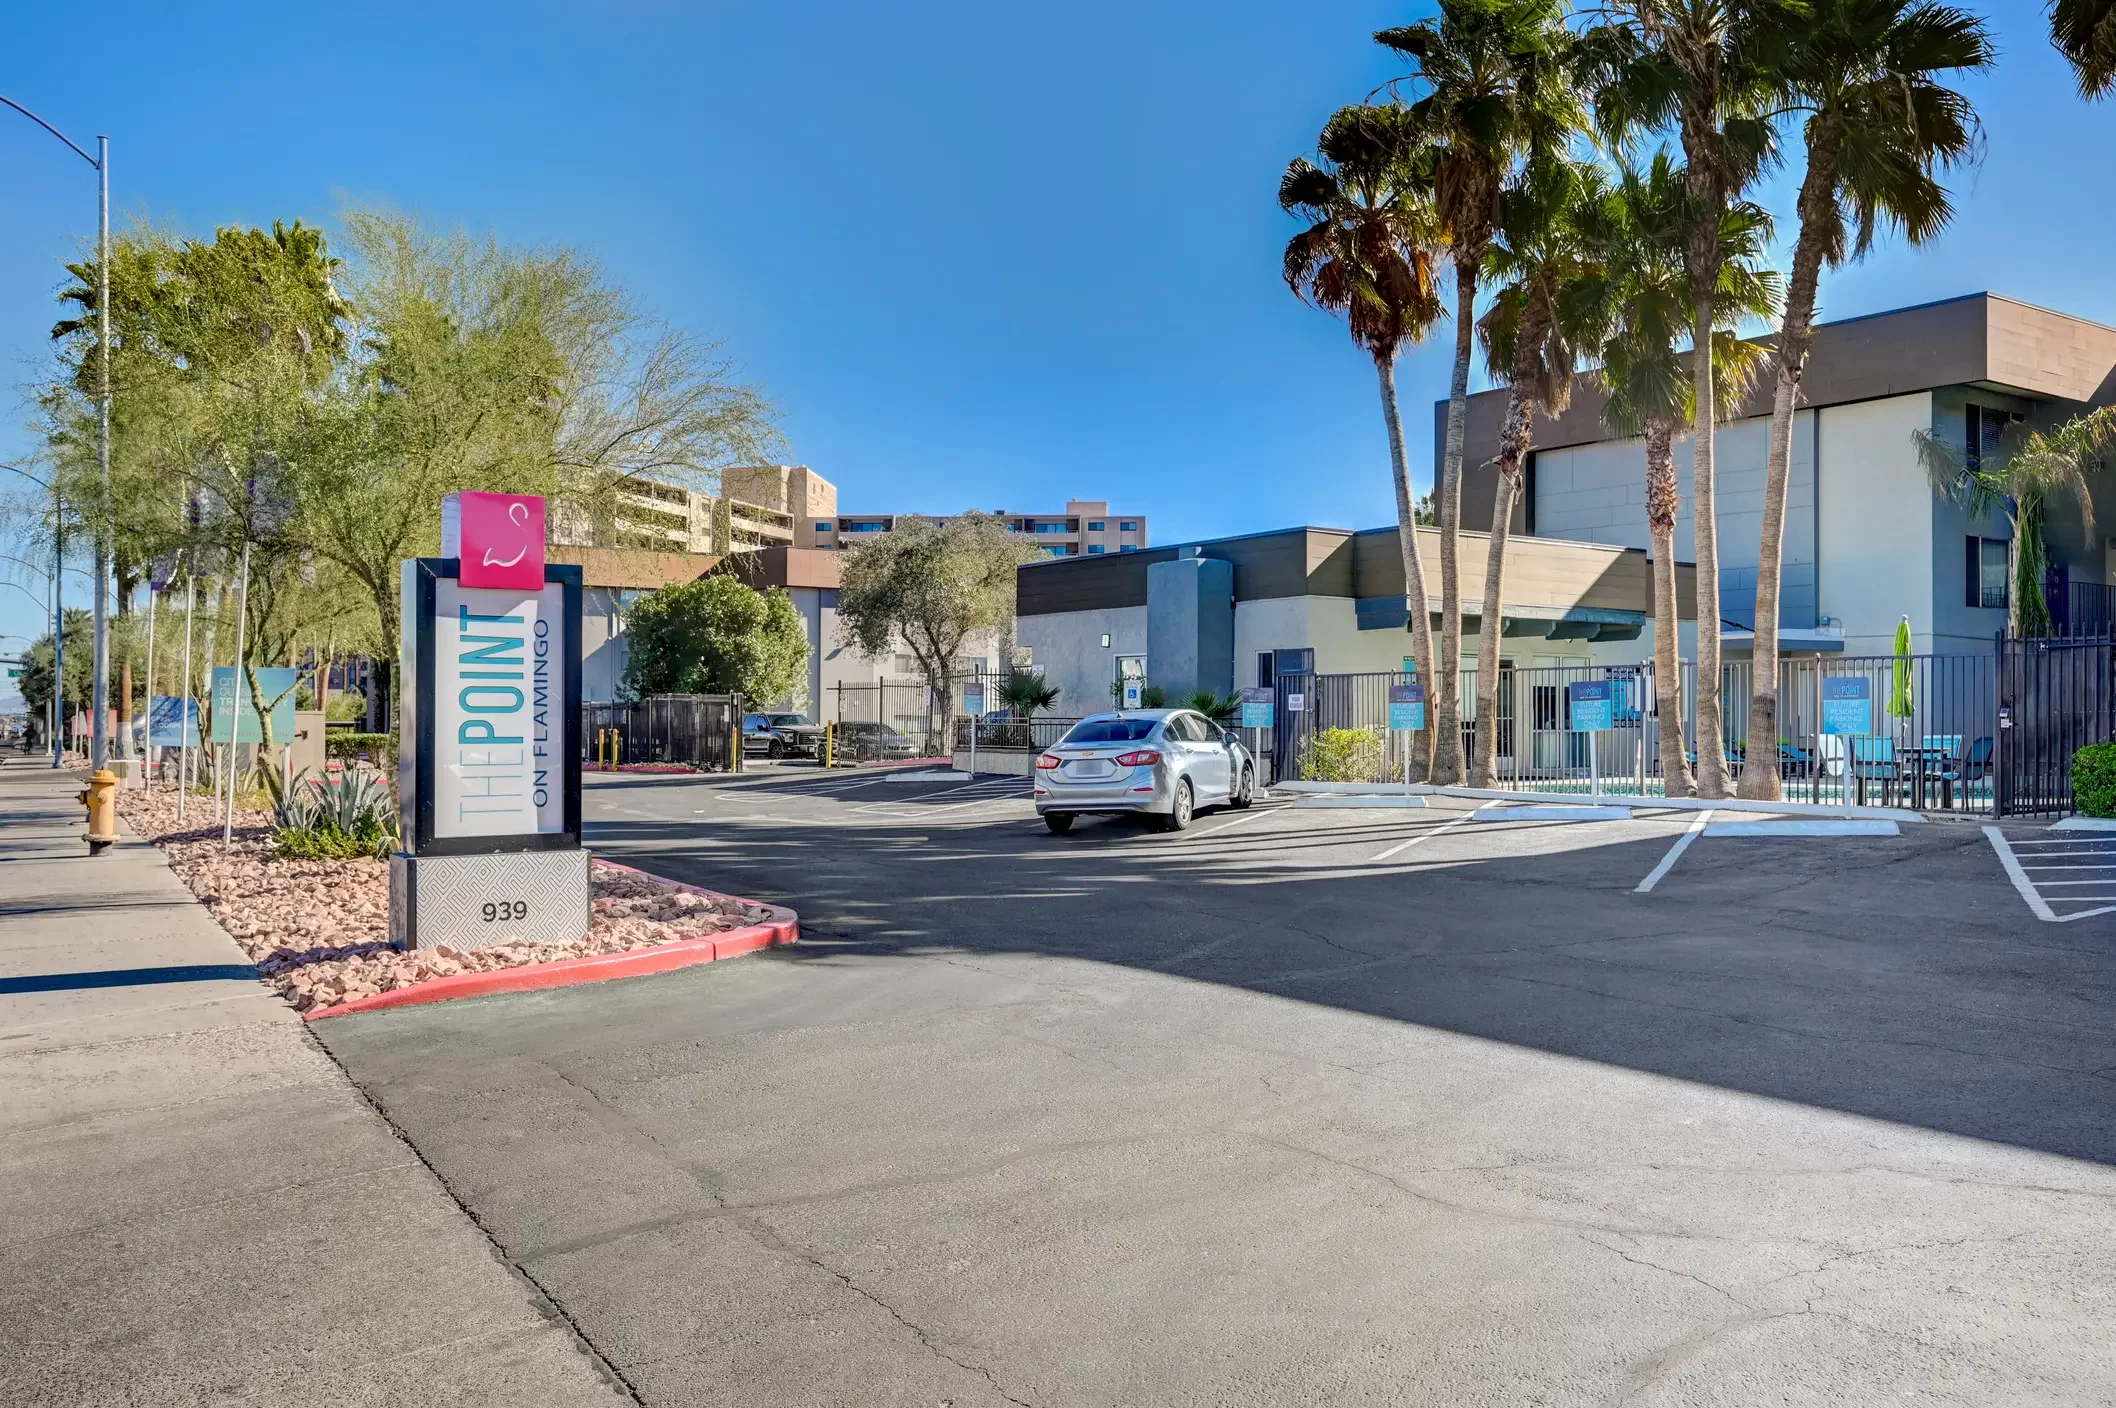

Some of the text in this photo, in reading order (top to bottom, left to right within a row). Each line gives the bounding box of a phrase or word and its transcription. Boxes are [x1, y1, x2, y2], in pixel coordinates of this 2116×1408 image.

[532, 618, 550, 809] ON FLAMINGO
[1833, 700, 1860, 708] FUTURE
[482, 900, 528, 923] 939
